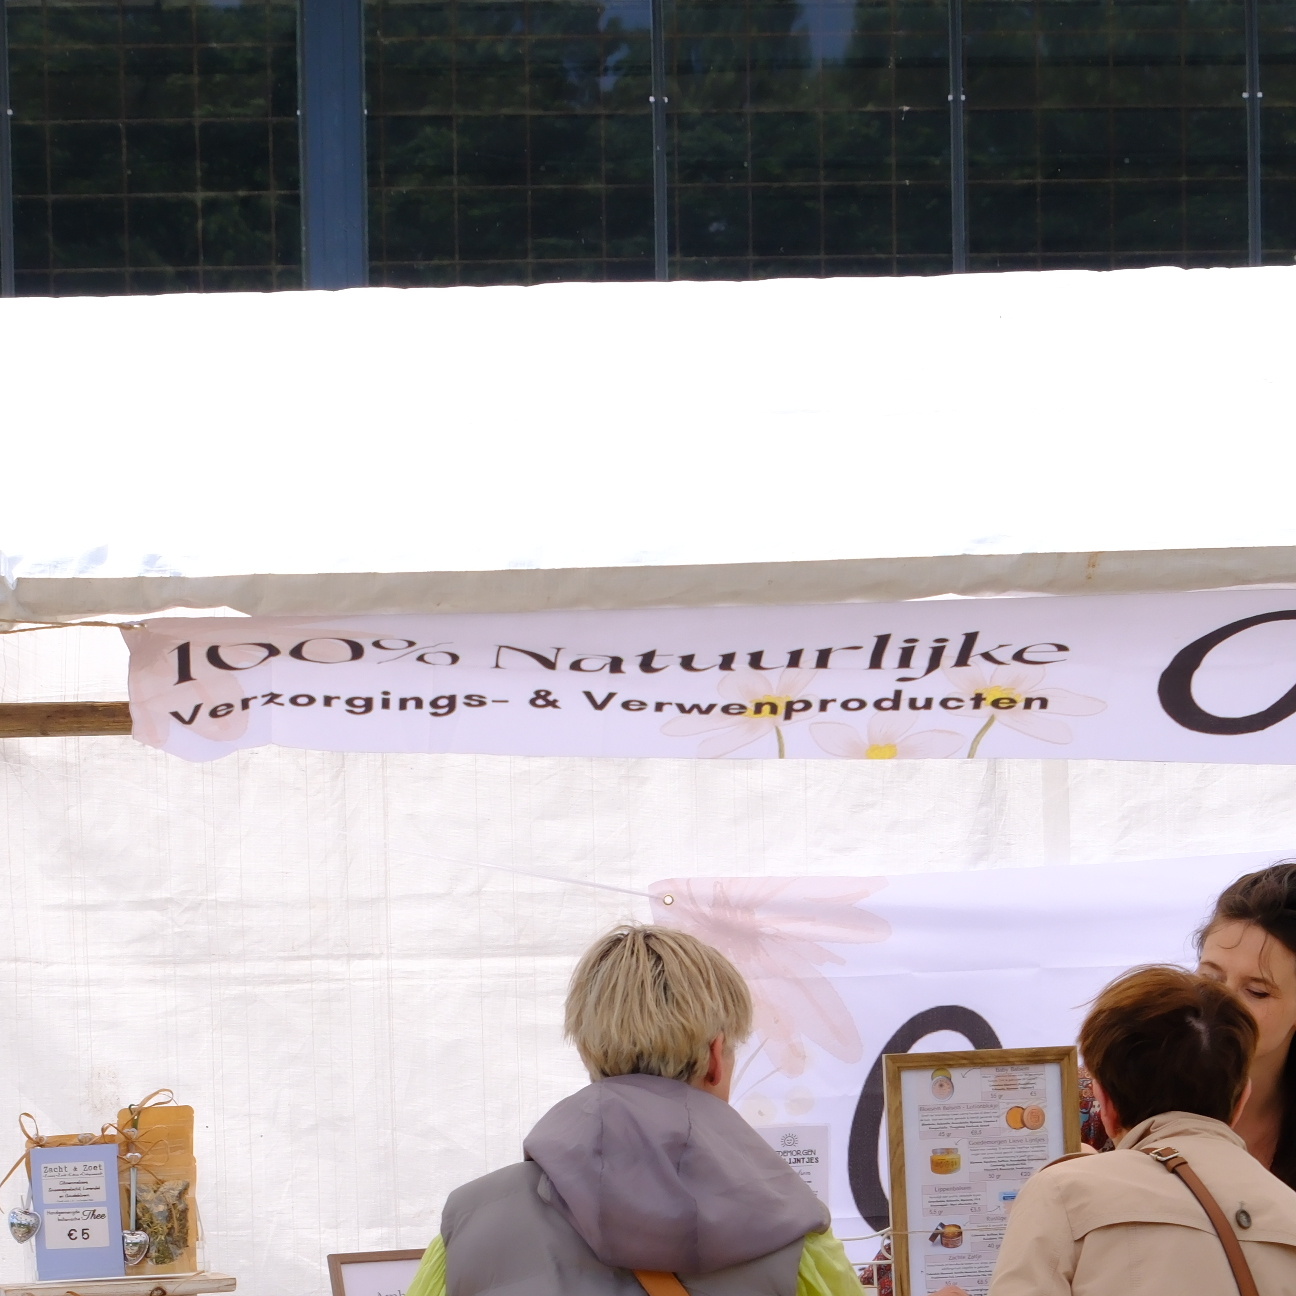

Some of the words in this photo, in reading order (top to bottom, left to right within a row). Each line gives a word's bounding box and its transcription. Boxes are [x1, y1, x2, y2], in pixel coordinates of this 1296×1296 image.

[171, 638, 459, 685] 100%
[495, 631, 1069, 681] Natuurlijke
[170, 690, 510, 728] Verzorgings-
[528, 689, 562, 711] &
[584, 690, 1048, 720] Verwenproducten
